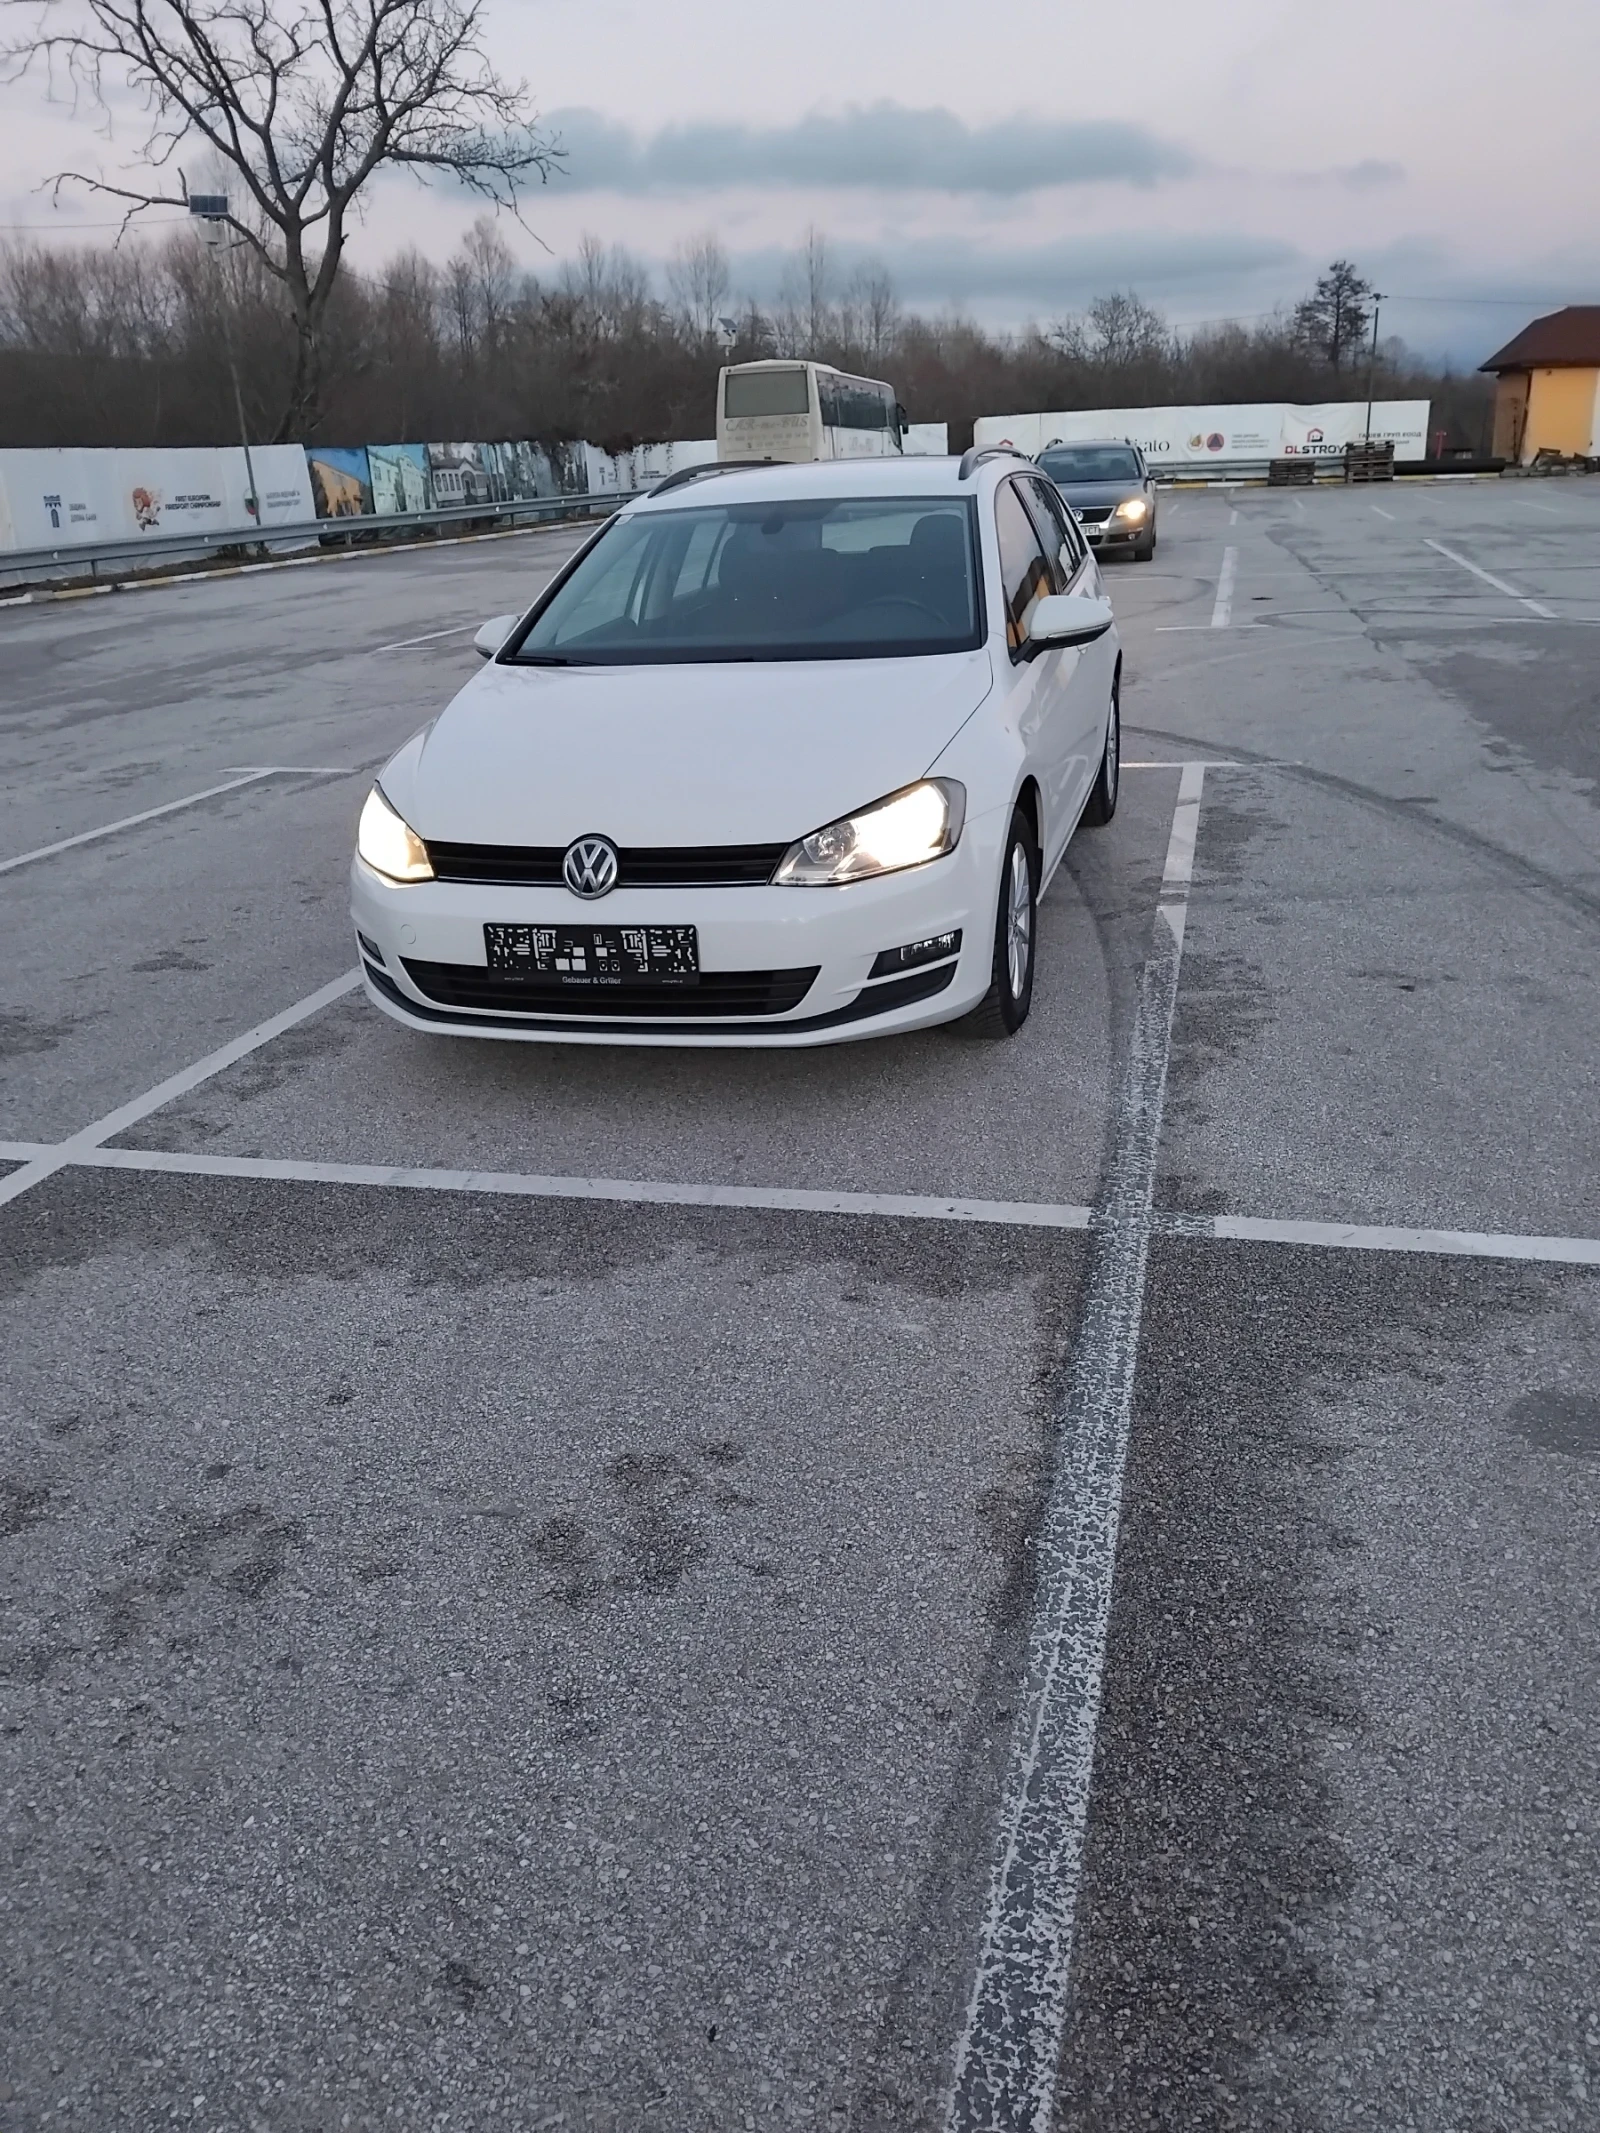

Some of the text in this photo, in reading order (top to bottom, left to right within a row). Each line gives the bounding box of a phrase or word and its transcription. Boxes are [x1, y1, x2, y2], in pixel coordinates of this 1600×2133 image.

[1284, 444, 1347, 455] DLSTROY
[562, 976, 591, 984] Gebauer
[592, 976, 599, 984] &
